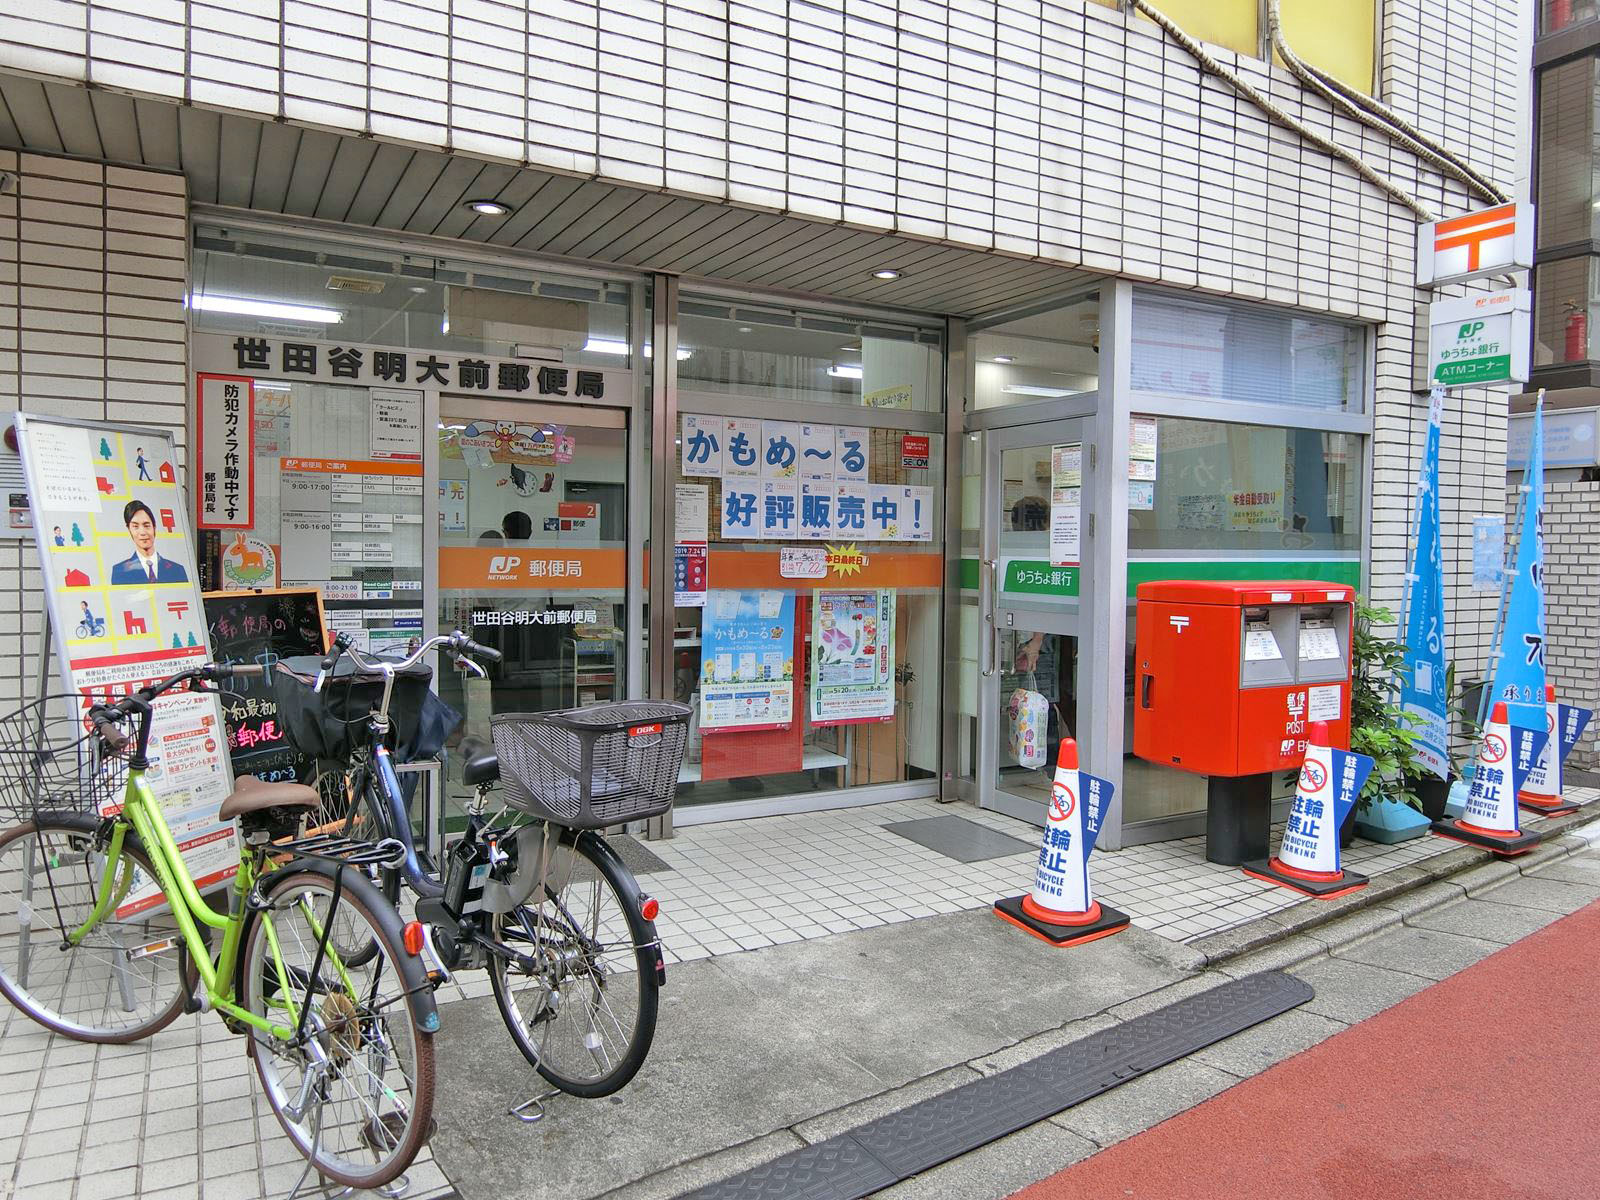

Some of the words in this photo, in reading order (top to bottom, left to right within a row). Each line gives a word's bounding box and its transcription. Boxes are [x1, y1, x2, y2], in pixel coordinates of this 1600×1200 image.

[1458, 322, 1484, 338] JP
[1441, 343, 1500, 359] ゆうちょ銀行
[233, 337, 604, 398] 世田谷明大前郵便局
[1441, 361, 1504, 376] ATMコーナー
[224, 384, 239, 520] 防犯カメラ作動中です
[686, 428, 867, 473] かもめ〜る
[204, 472, 216, 513] 郵便局長
[587, 506, 594, 516] 2
[725, 490, 921, 529] 好評販売中！
[250, 541, 273, 559] supporter
[490, 556, 521, 574] JP
[529, 560, 582, 577] 郵便局
[1016, 570, 1072, 586] ゆうちょ銀行
[472, 610, 597, 625] 世田谷明大前郵便局
[715, 627, 769, 640] かもめ〜る
[1286, 692, 1305, 707] 郵便
[1286, 720, 1304, 734] POST
[1564, 708, 1580, 743] 駐輪禁止
[1280, 739, 1295, 751] JP
[1518, 730, 1534, 770] 駐輪禁止
[1340, 755, 1357, 802] 駐輪禁止
[1475, 765, 1504, 785] 駐輪
[1470, 782, 1500, 802] 禁止
[1087, 779, 1100, 833] 駐輪禁止
[1465, 805, 1497, 820] PARKING
[1474, 800, 1499, 812] BICYCLE
[1287, 815, 1320, 839] 禁止
[1283, 843, 1316, 859] PARKING
[1291, 835, 1318, 850] BICYCLE
[1039, 869, 1064, 886] BICYCLE
